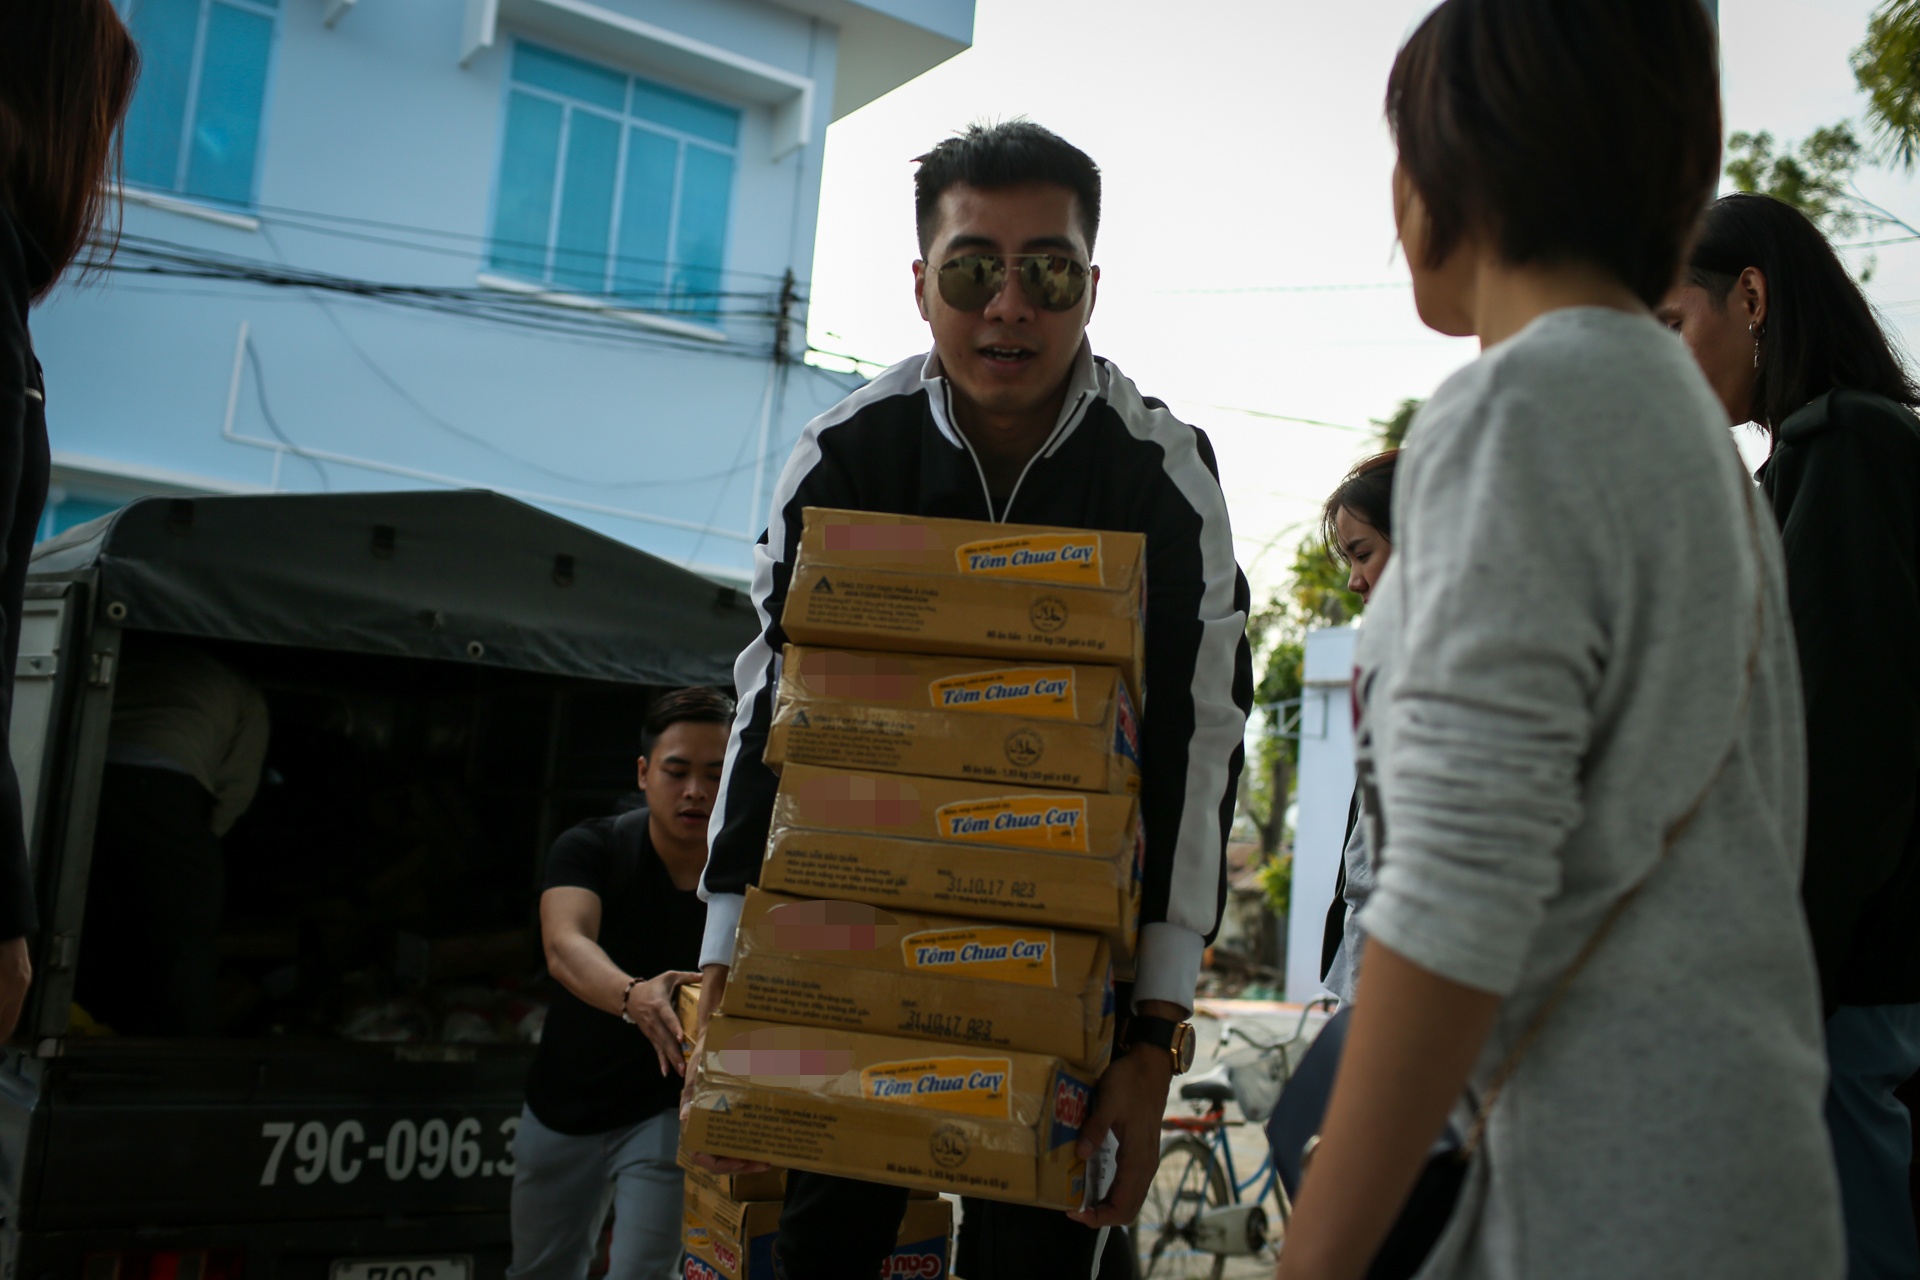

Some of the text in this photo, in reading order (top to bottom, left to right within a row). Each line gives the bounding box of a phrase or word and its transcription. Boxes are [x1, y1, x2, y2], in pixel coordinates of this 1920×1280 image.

[969, 546, 1093, 570] Tôm Chua Cay
[943, 679, 1067, 704] Tôm Chua Cay
[951, 809, 1079, 834] Tôm Chua Cay
[947, 875, 1005, 895] 31.10.17
[916, 940, 1047, 965] Tôm Chua Cay
[874, 1072, 1003, 1096] Tôm Chua Cay
